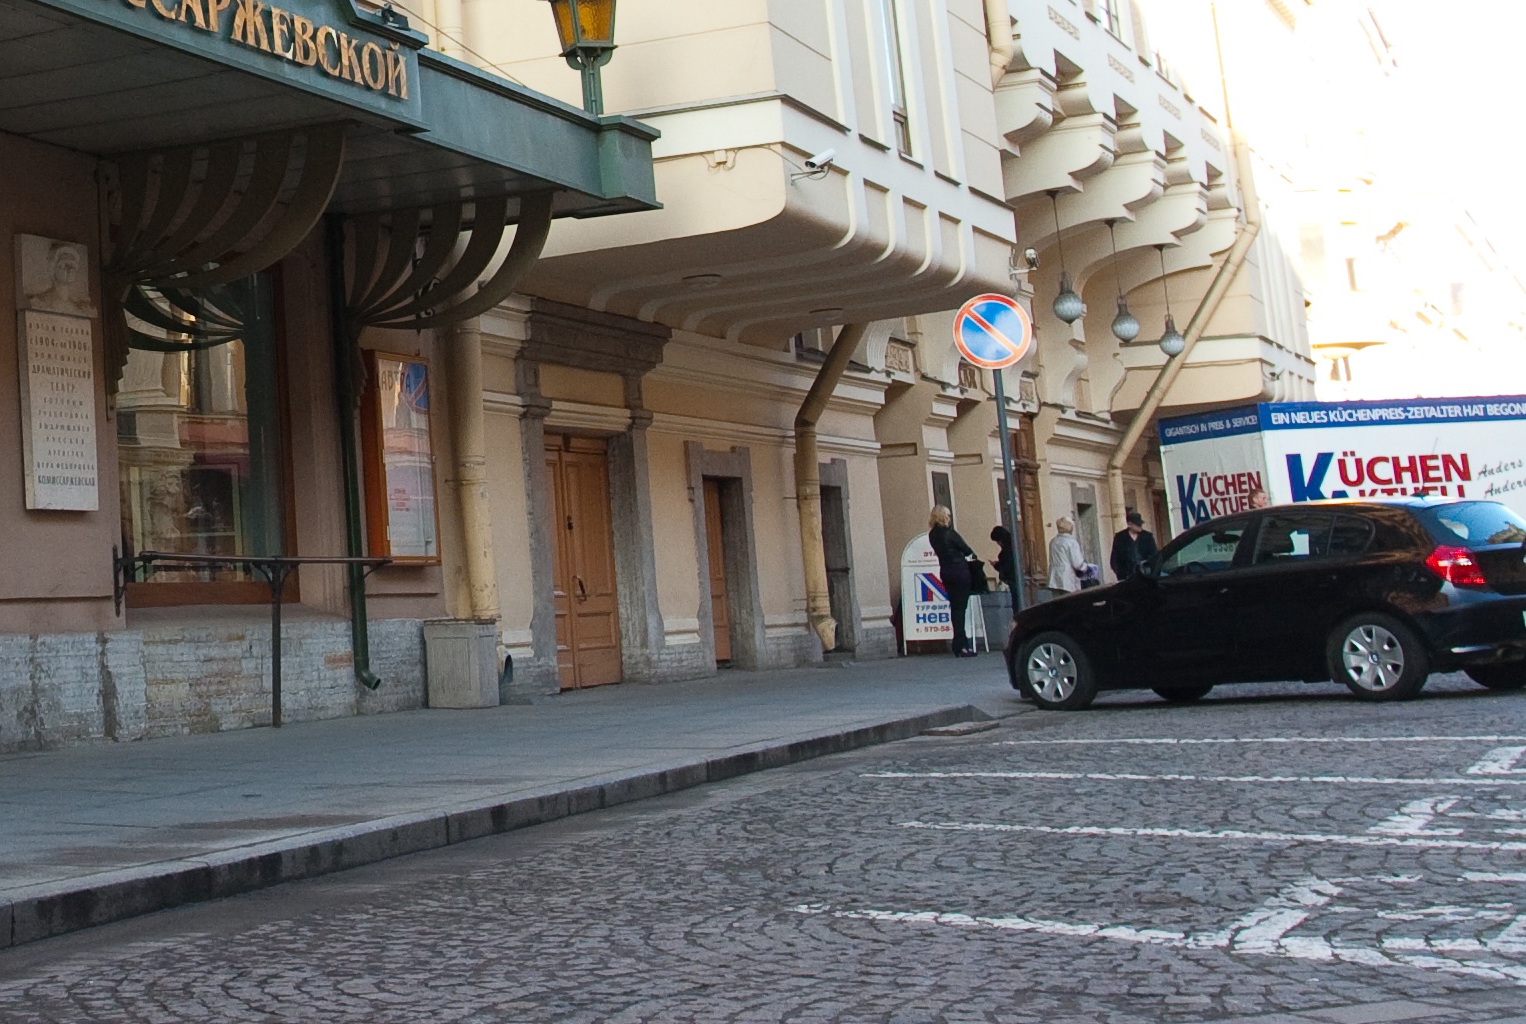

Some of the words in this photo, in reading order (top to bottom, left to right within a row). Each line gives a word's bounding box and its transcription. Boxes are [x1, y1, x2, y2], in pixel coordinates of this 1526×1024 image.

[1200, 423, 1208, 432] IN
[1208, 420, 1224, 431] PREIS
[1270, 412, 1290, 425] EIN
[1291, 410, 1328, 424] NEUES
[1329, 405, 1463, 422] KÜCHENPREIS-ZEITALTER
[1463, 404, 1485, 418] HAT
[1286, 451, 1472, 502] KÜCHEN
[1176, 470, 1263, 530] KÜCHEN
